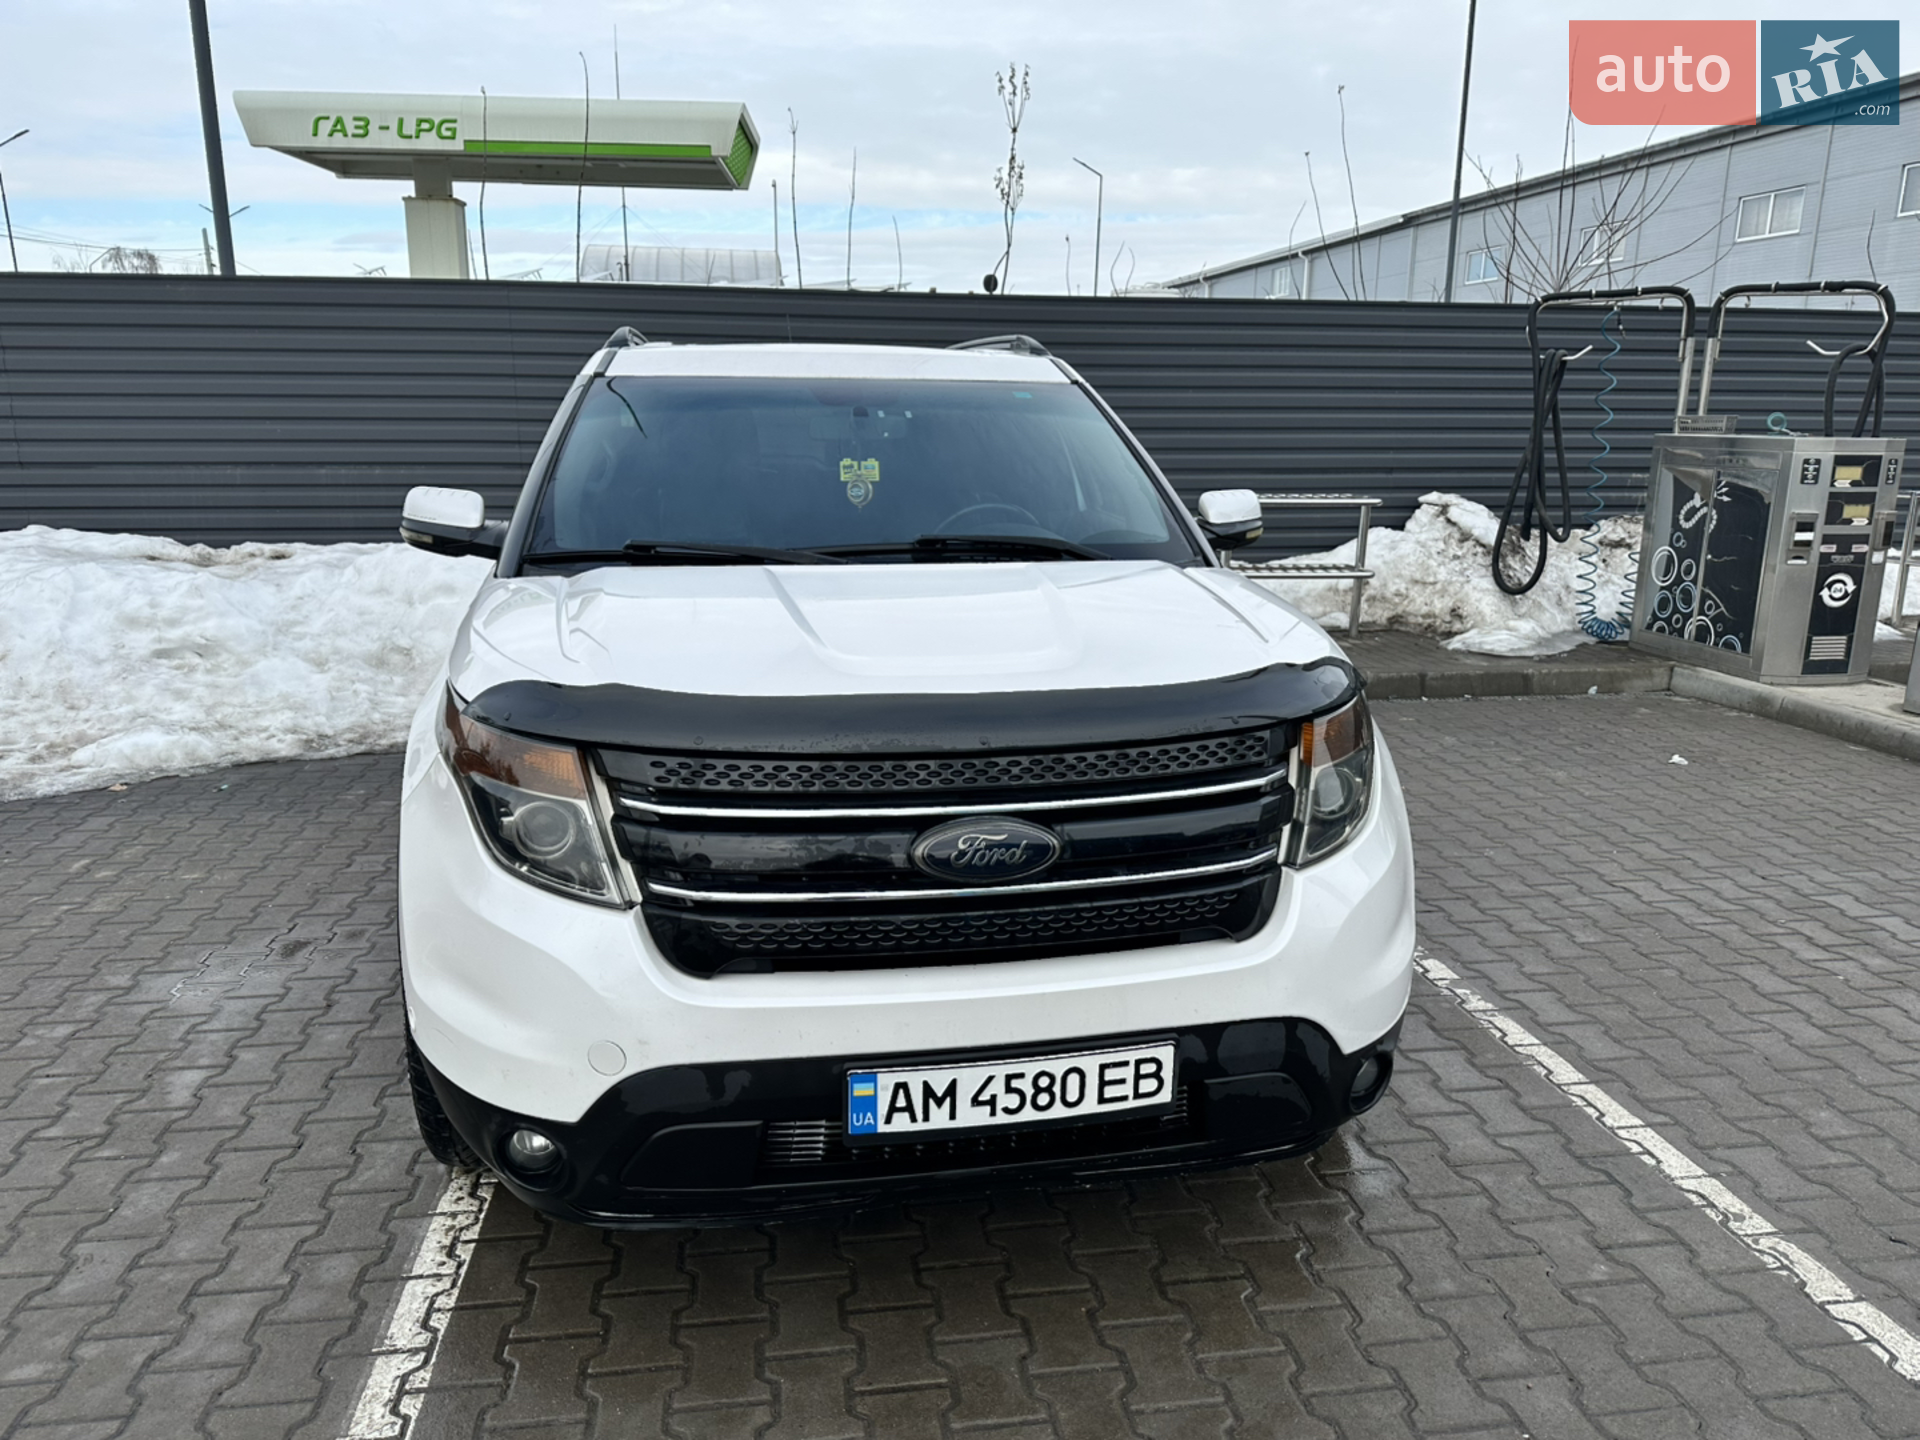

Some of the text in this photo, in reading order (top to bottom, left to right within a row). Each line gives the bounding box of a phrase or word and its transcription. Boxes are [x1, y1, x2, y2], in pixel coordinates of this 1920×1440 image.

[950, 833, 1028, 868] Ford
[883, 1057, 1165, 1125] AM 4580 EB
[852, 1112, 875, 1127] UA
